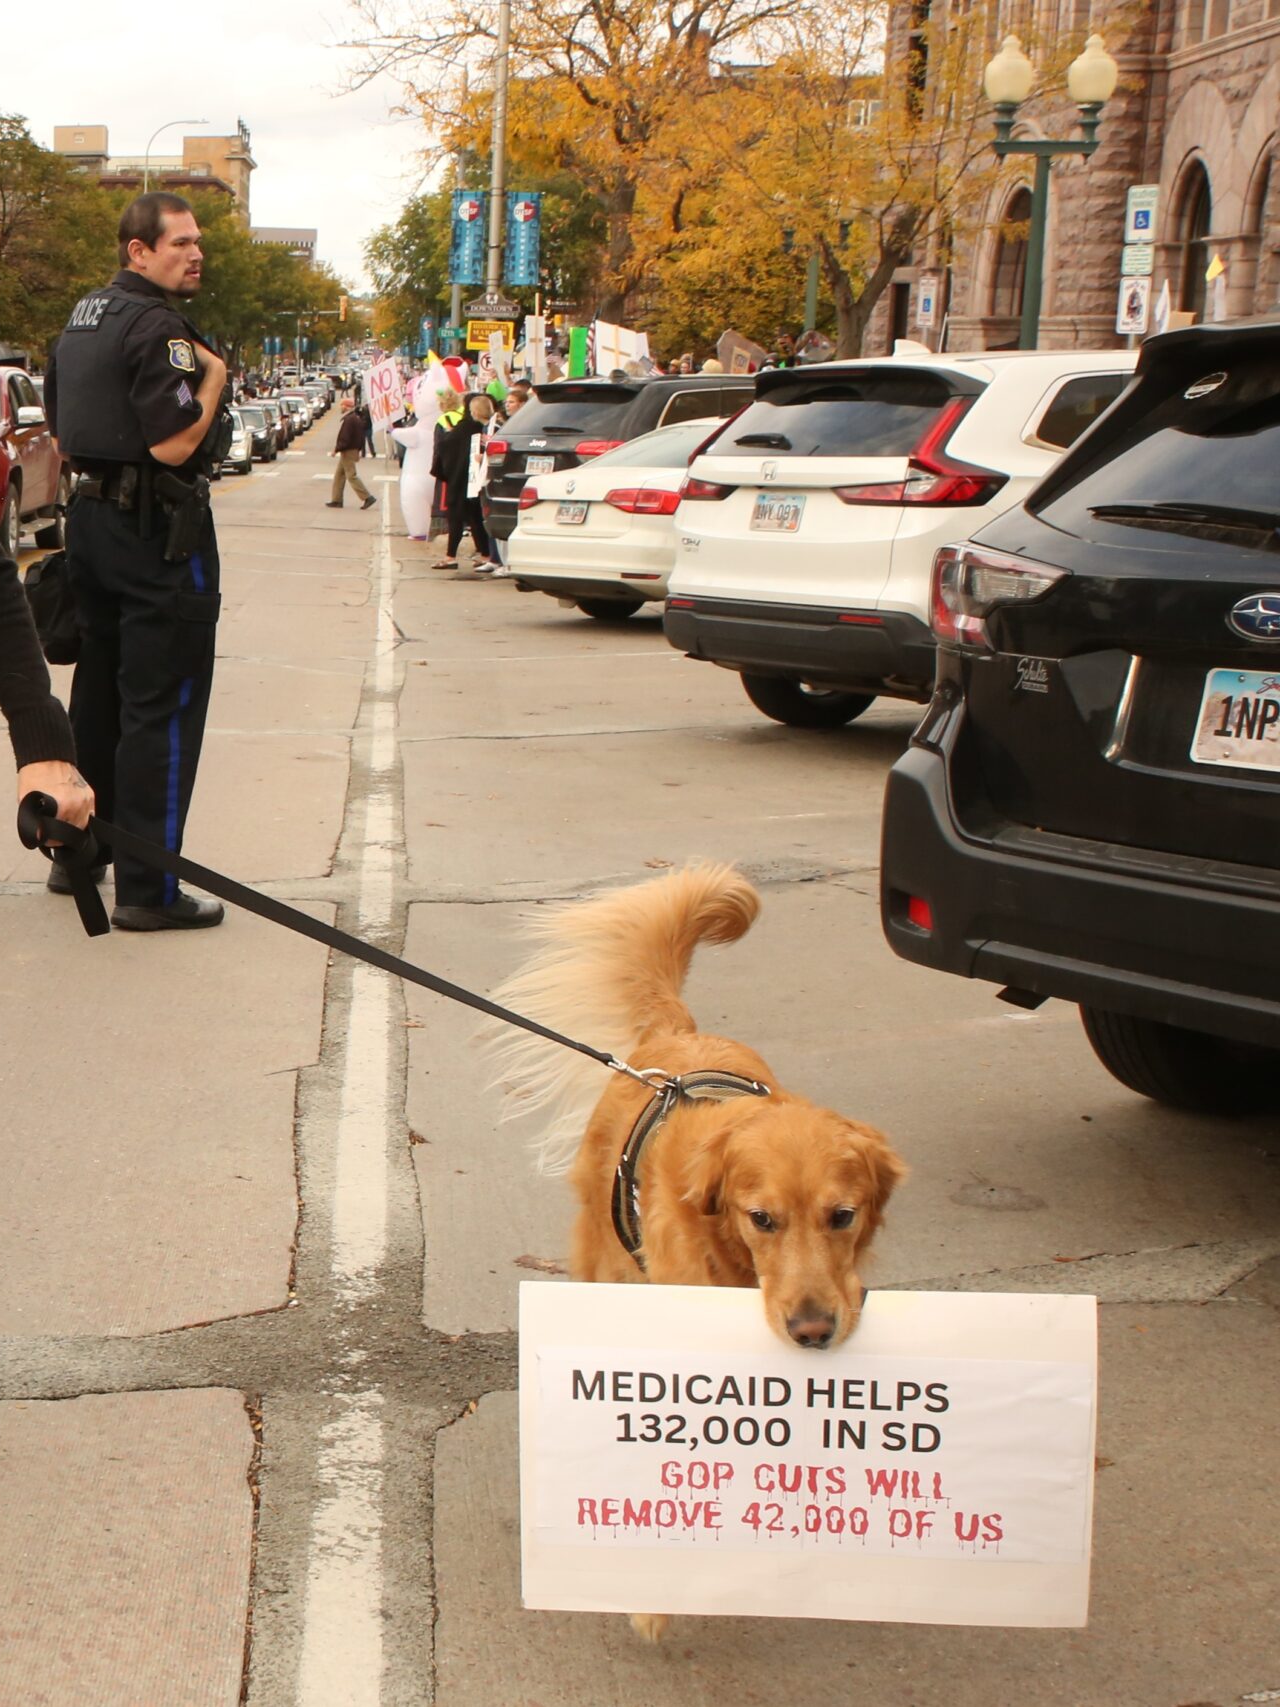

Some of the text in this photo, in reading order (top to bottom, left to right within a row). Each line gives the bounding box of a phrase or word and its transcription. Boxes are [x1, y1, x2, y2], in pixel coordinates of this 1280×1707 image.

[470, 305, 513, 313] DOWNTOWN
[370, 368, 392, 399] NO
[372, 388, 401, 422] KINGS
[529, 439, 547, 447] Jeep
[572, 1369, 950, 1413] MEDICAID HELPS
[616, 1413, 941, 1453] 132,000 IN SD
[661, 1461, 952, 1503] GOP CUTS WILL
[577, 1498, 1004, 1545] REMOVE 42,000 OF US
